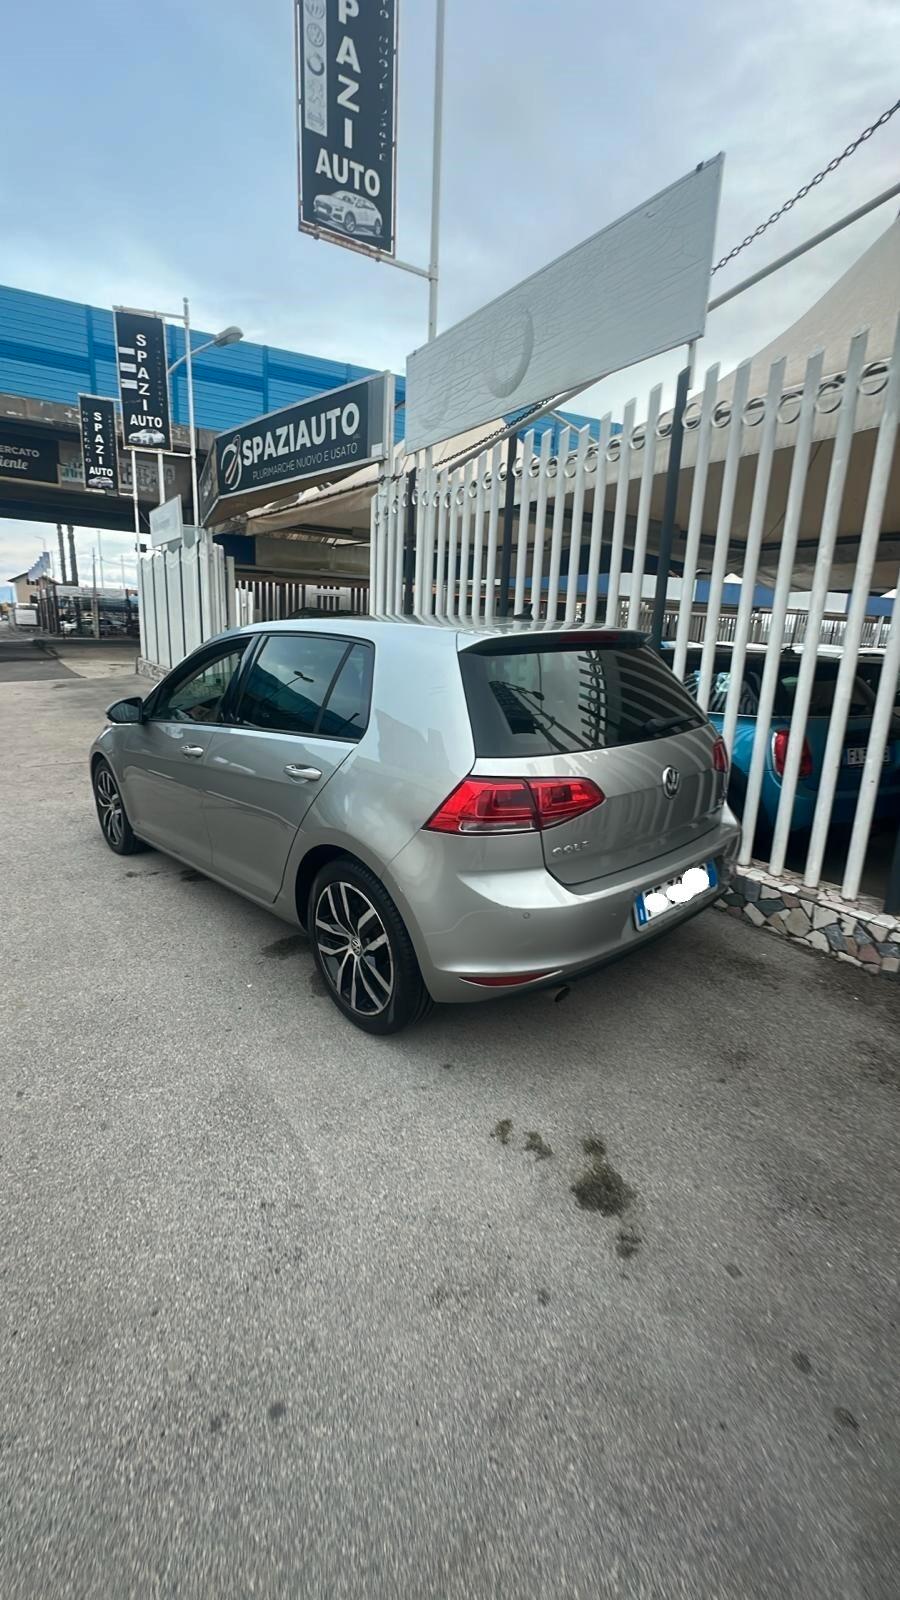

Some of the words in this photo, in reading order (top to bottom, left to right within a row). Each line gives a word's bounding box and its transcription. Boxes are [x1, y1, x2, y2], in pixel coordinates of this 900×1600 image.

[315, 147, 381, 198] AUTO
[136, 333, 151, 412] SPAZI
[93, 411, 105, 465] SPAZI
[130, 413, 163, 429] AUTO
[241, 402, 360, 467] SPAZIAUTO
[89, 466, 114, 477] AUTO
[252, 459, 295, 480] PLURIMARCHE
[295, 452, 323, 469] NUOVO
[323, 450, 329, 462] E
[330, 442, 358, 460] USATO
